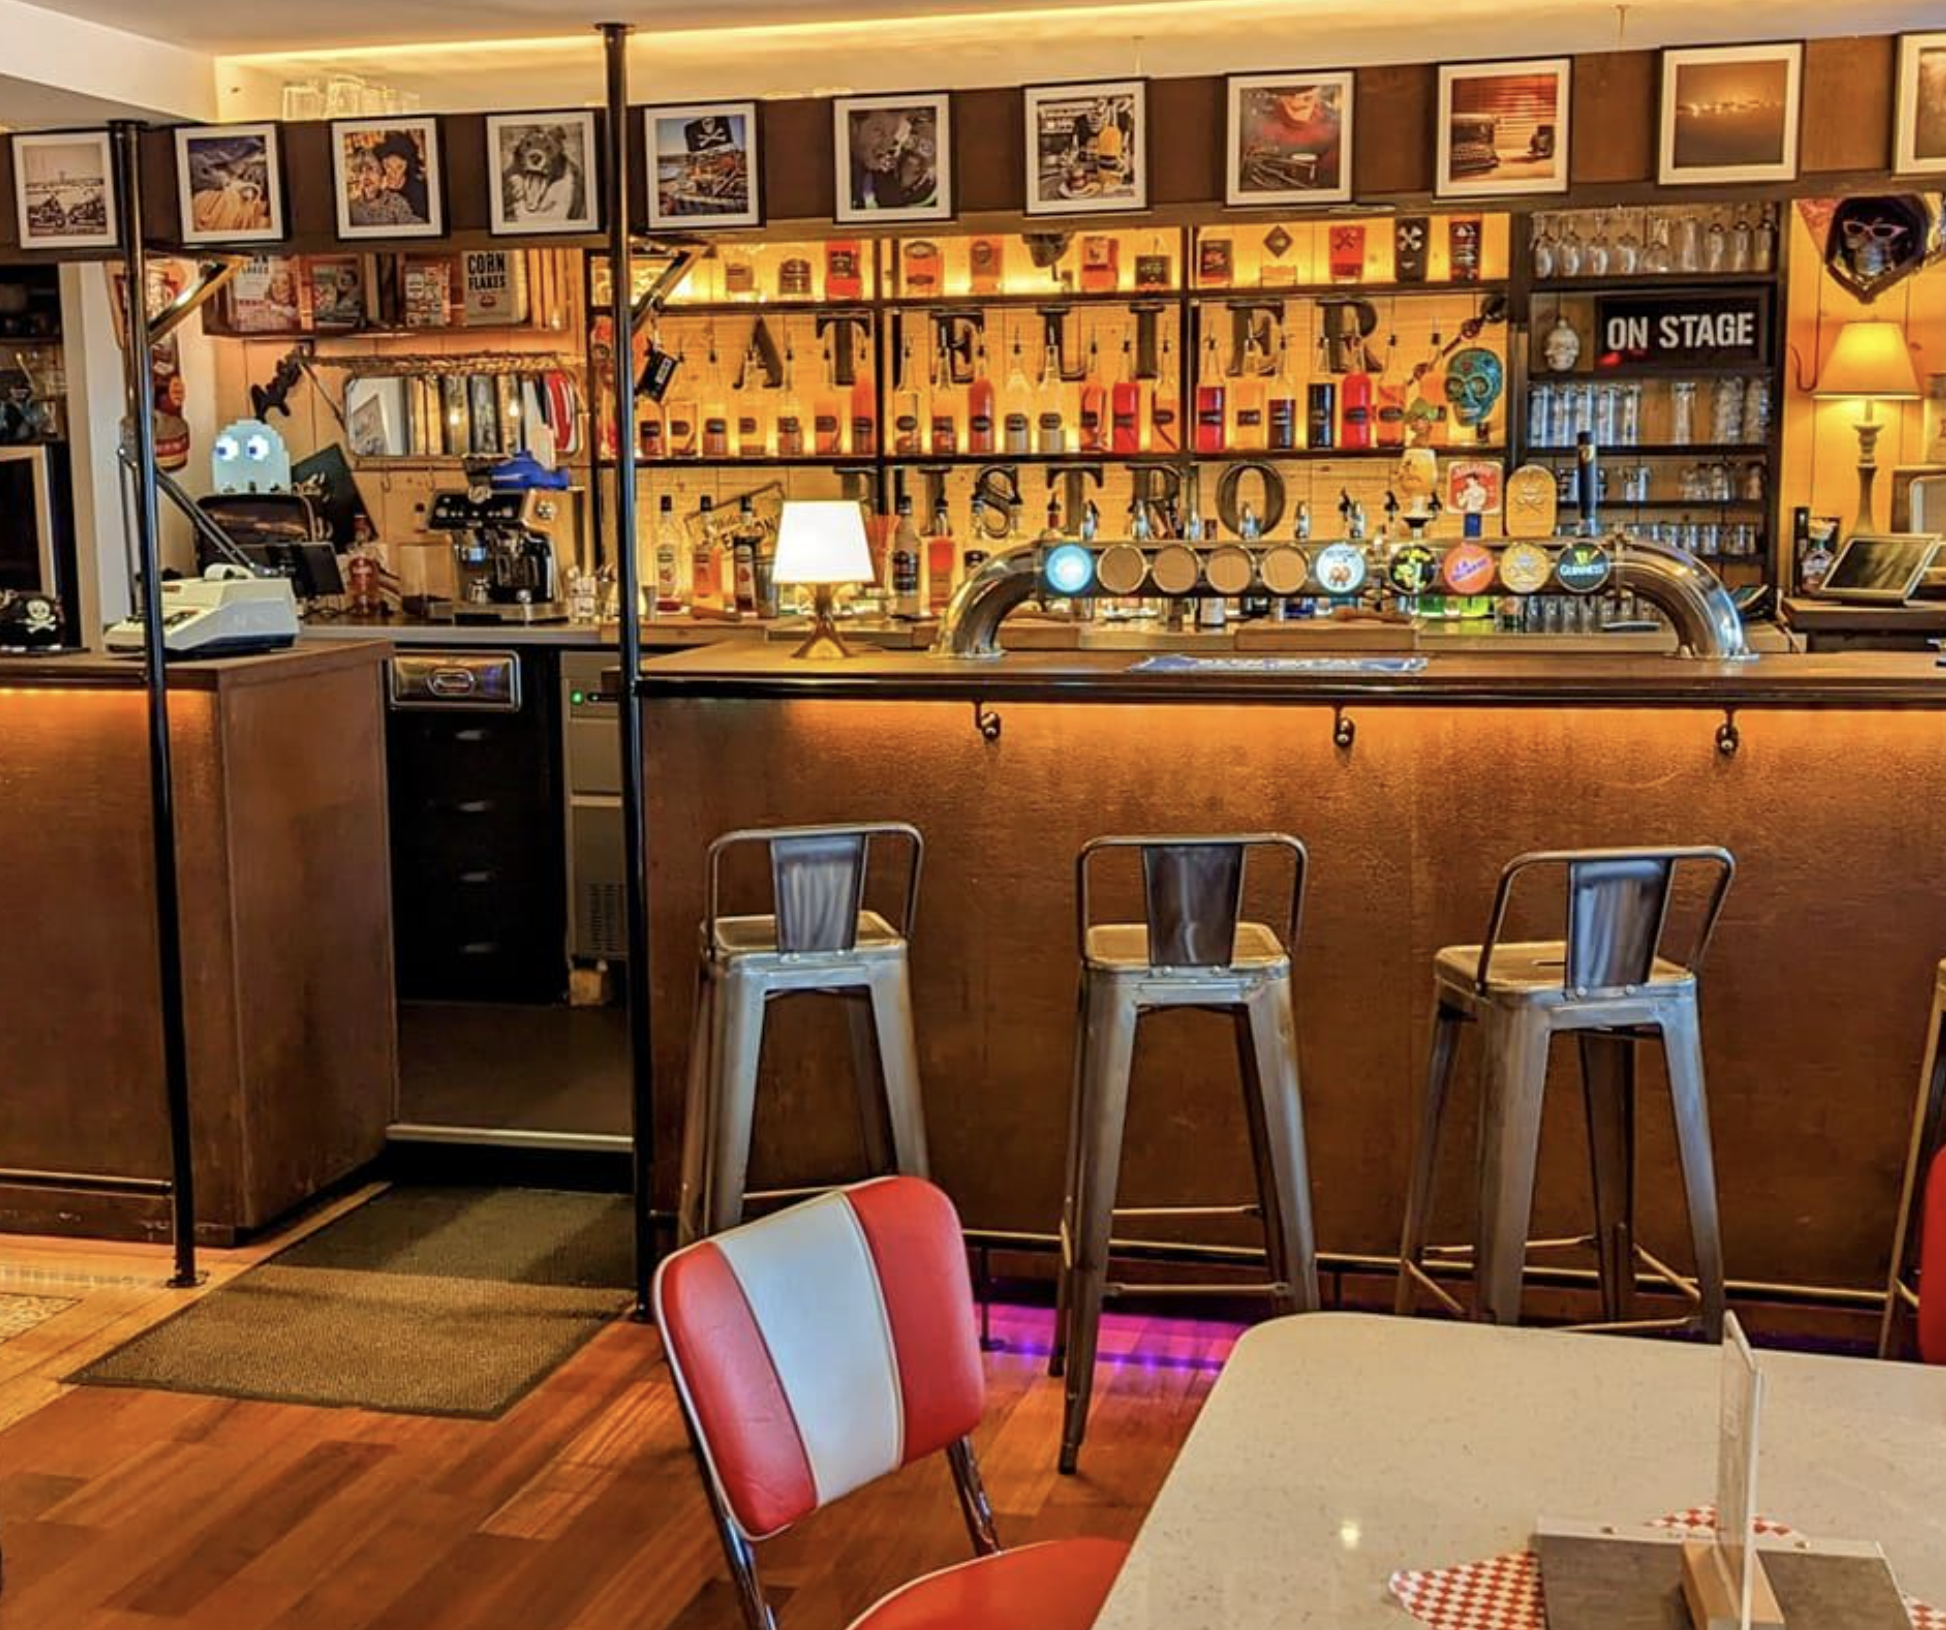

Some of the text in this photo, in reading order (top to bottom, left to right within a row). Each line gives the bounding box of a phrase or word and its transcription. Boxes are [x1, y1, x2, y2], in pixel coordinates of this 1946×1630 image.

[468, 252, 505, 274] CORN
[468, 275, 506, 291] FLAKES
[732, 298, 1383, 390] ATELIER
[1607, 312, 1754, 350] ON STAGE
